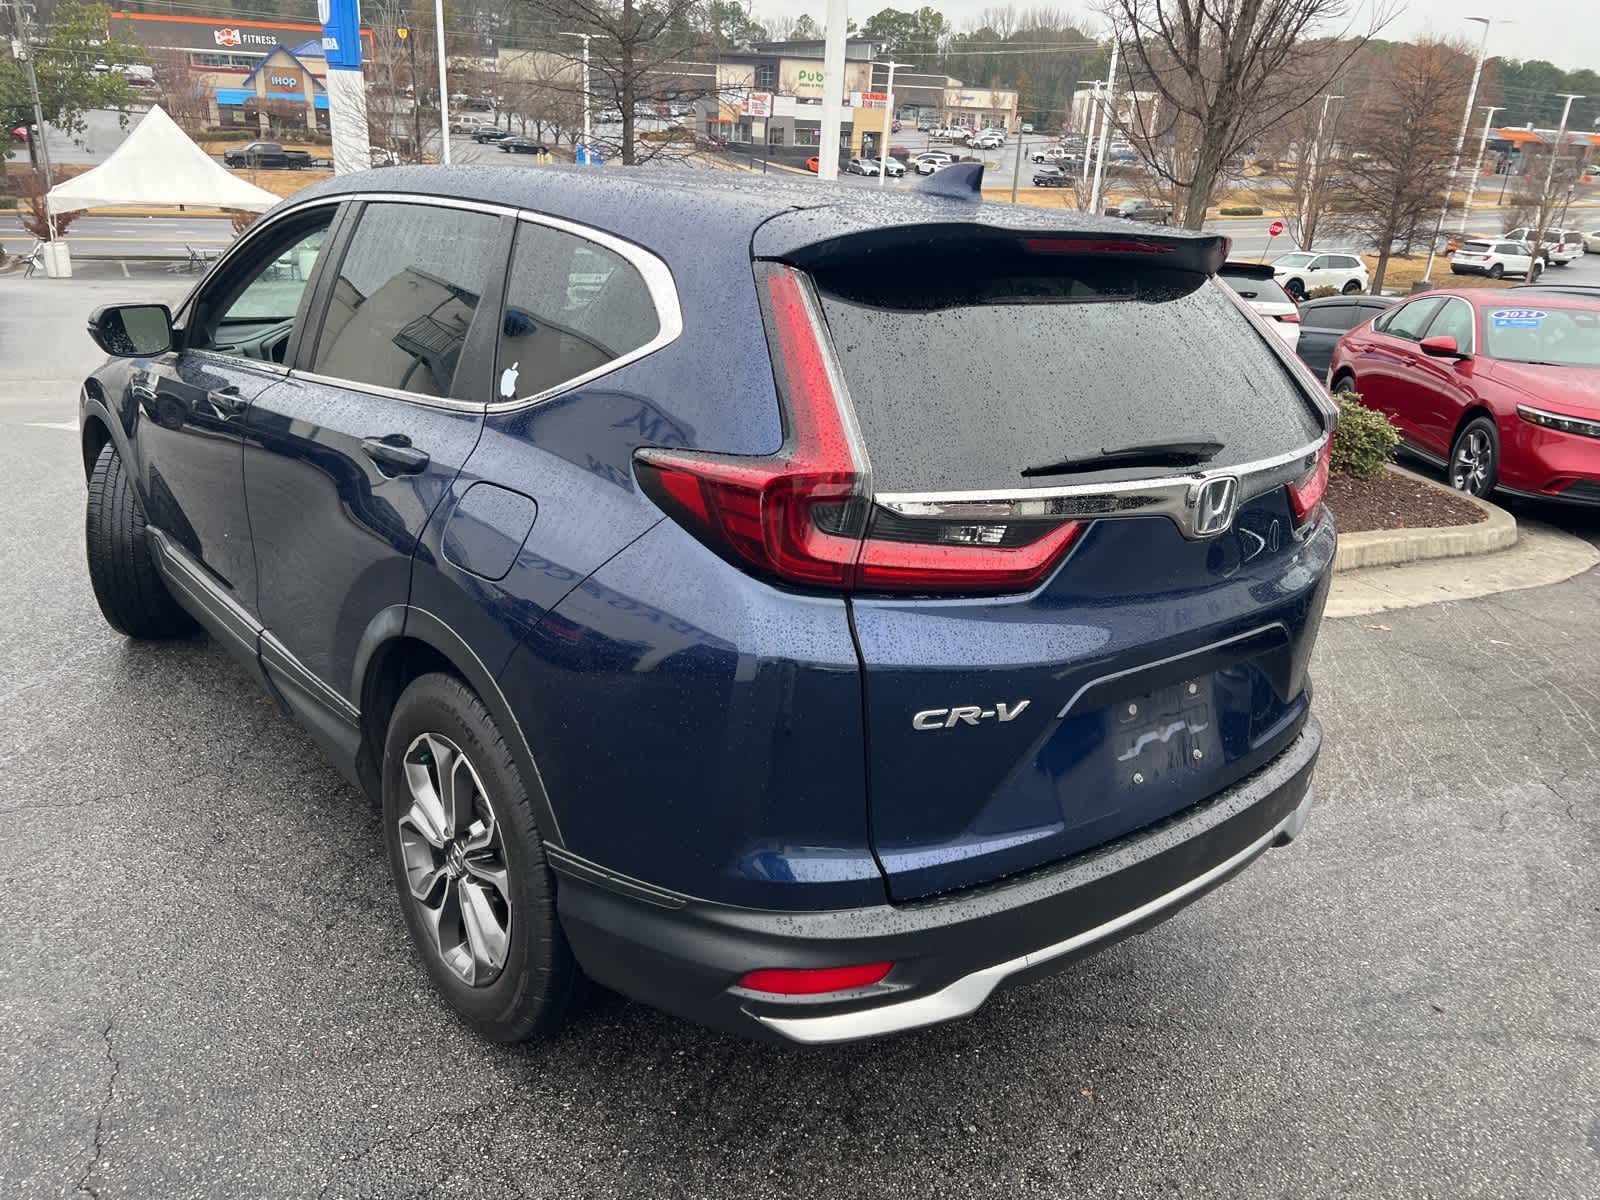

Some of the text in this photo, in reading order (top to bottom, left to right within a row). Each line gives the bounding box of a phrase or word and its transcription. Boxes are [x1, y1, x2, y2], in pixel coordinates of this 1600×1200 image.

[242, 34, 277, 45] FITNESS
[799, 70, 825, 82] Pub
[912, 700, 1031, 730] CR-V
